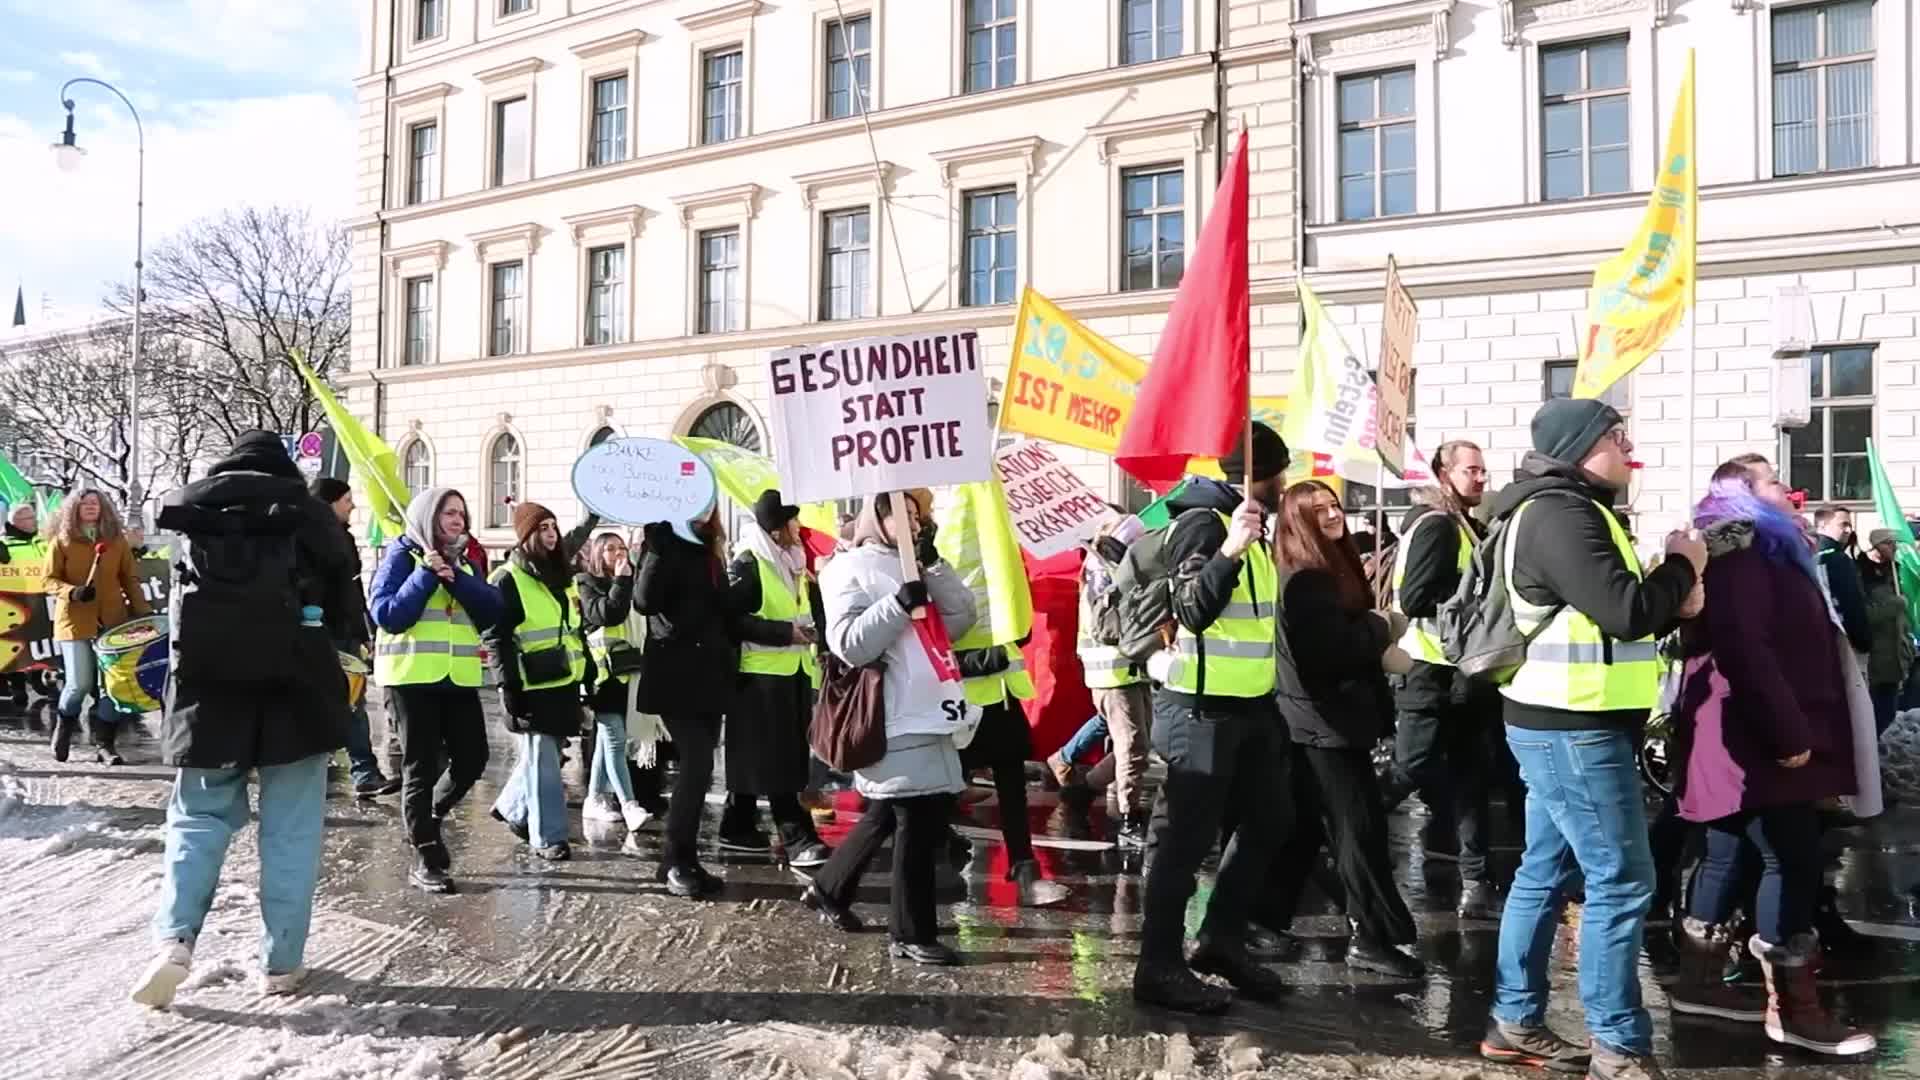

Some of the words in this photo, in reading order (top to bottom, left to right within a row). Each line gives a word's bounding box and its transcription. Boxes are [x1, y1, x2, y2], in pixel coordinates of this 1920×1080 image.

[771, 332, 978, 394] GESUNDHEIT
[842, 388, 925, 424] STATT
[1014, 371, 1064, 414] IST
[1066, 391, 1121, 437] MEHR
[831, 421, 963, 471] PROFITE
[996, 441, 1059, 484] ATIONS
